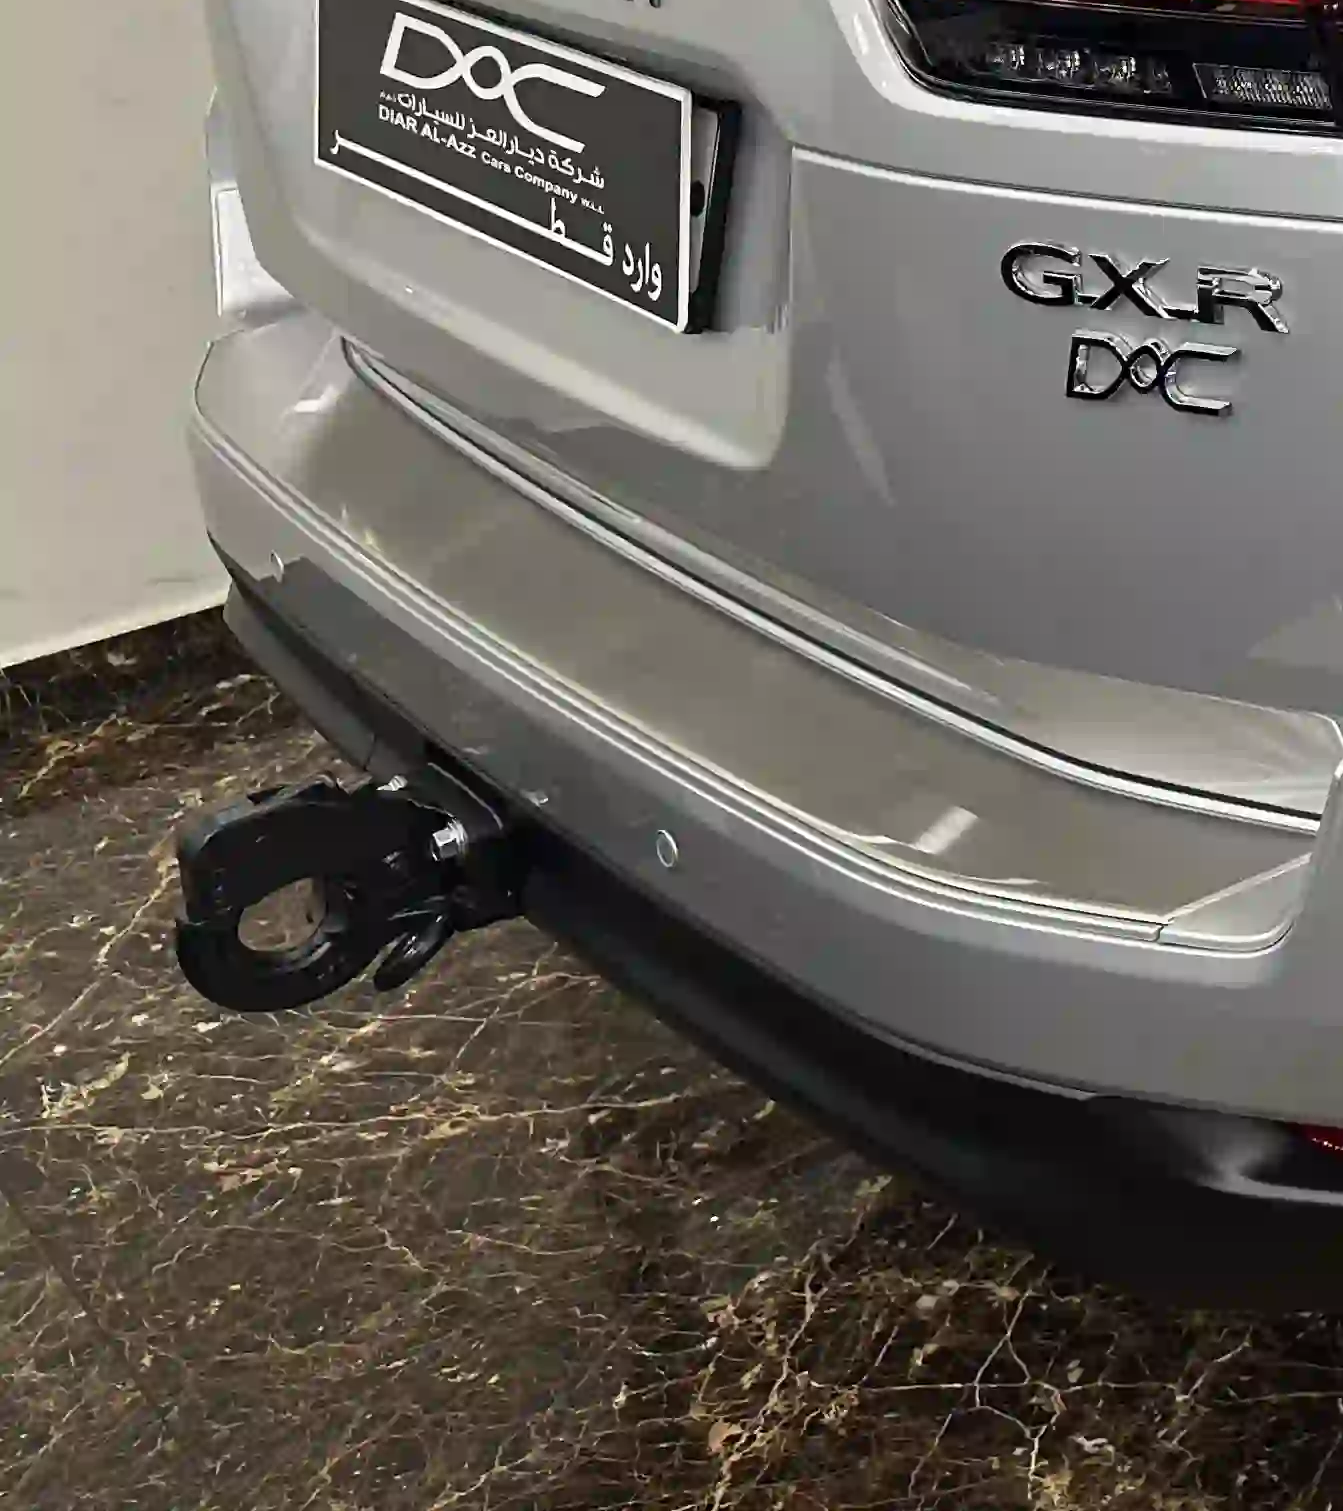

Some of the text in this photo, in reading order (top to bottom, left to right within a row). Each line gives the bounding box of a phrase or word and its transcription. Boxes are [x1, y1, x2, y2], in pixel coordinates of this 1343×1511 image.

[398, 94, 466, 131] للسيارات
[378, 103, 418, 134] DIAR
[481, 150, 512, 174] Cars
[514, 165, 578, 204] Company
[505, 135, 545, 166] ديار
[547, 149, 605, 189] شركة
[621, 241, 663, 302] وارد
